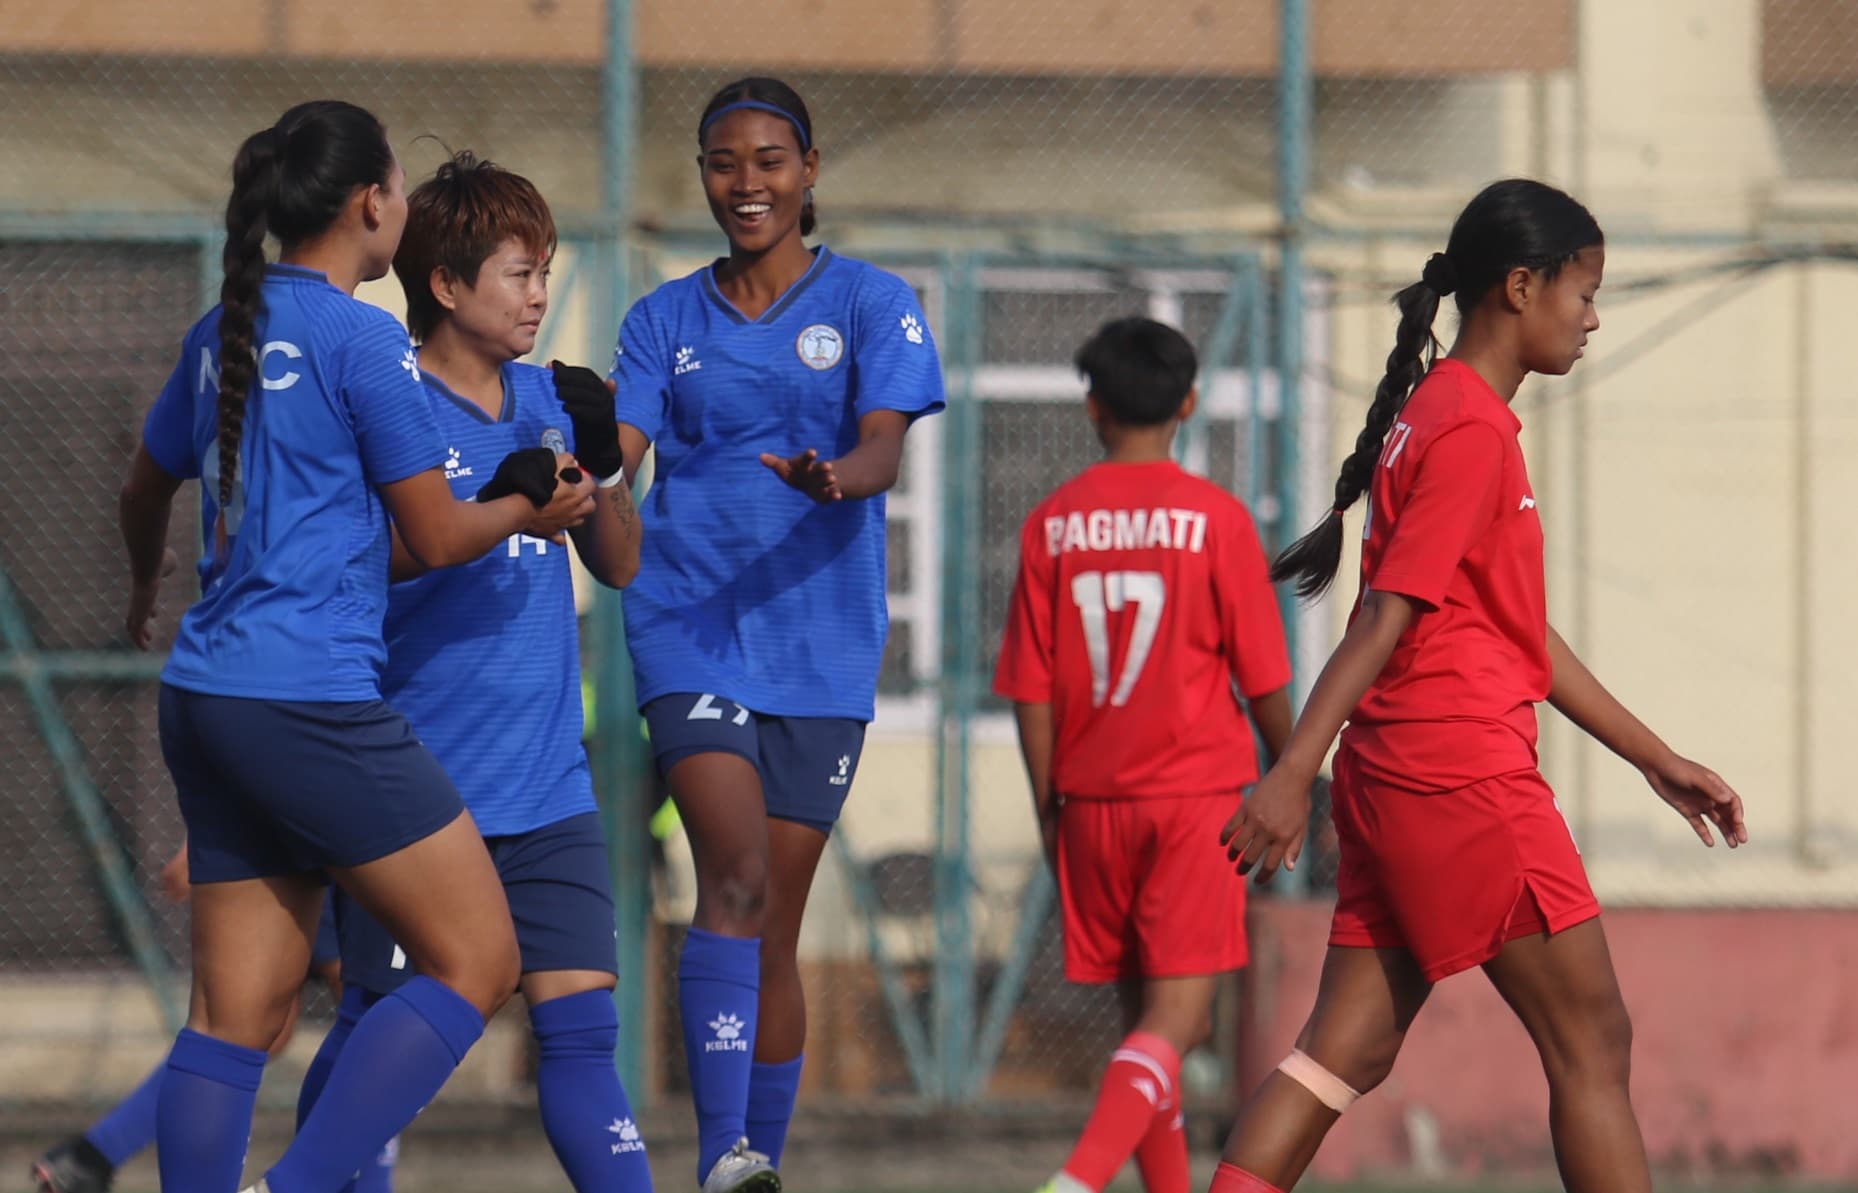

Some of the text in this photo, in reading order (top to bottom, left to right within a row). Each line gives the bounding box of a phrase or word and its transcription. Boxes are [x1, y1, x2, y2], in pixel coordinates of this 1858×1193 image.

[200, 341, 302, 394] NC
[675, 361, 701, 375] ELME
[445, 467, 473, 479] ELME
[1071, 570, 1165, 707] 17
